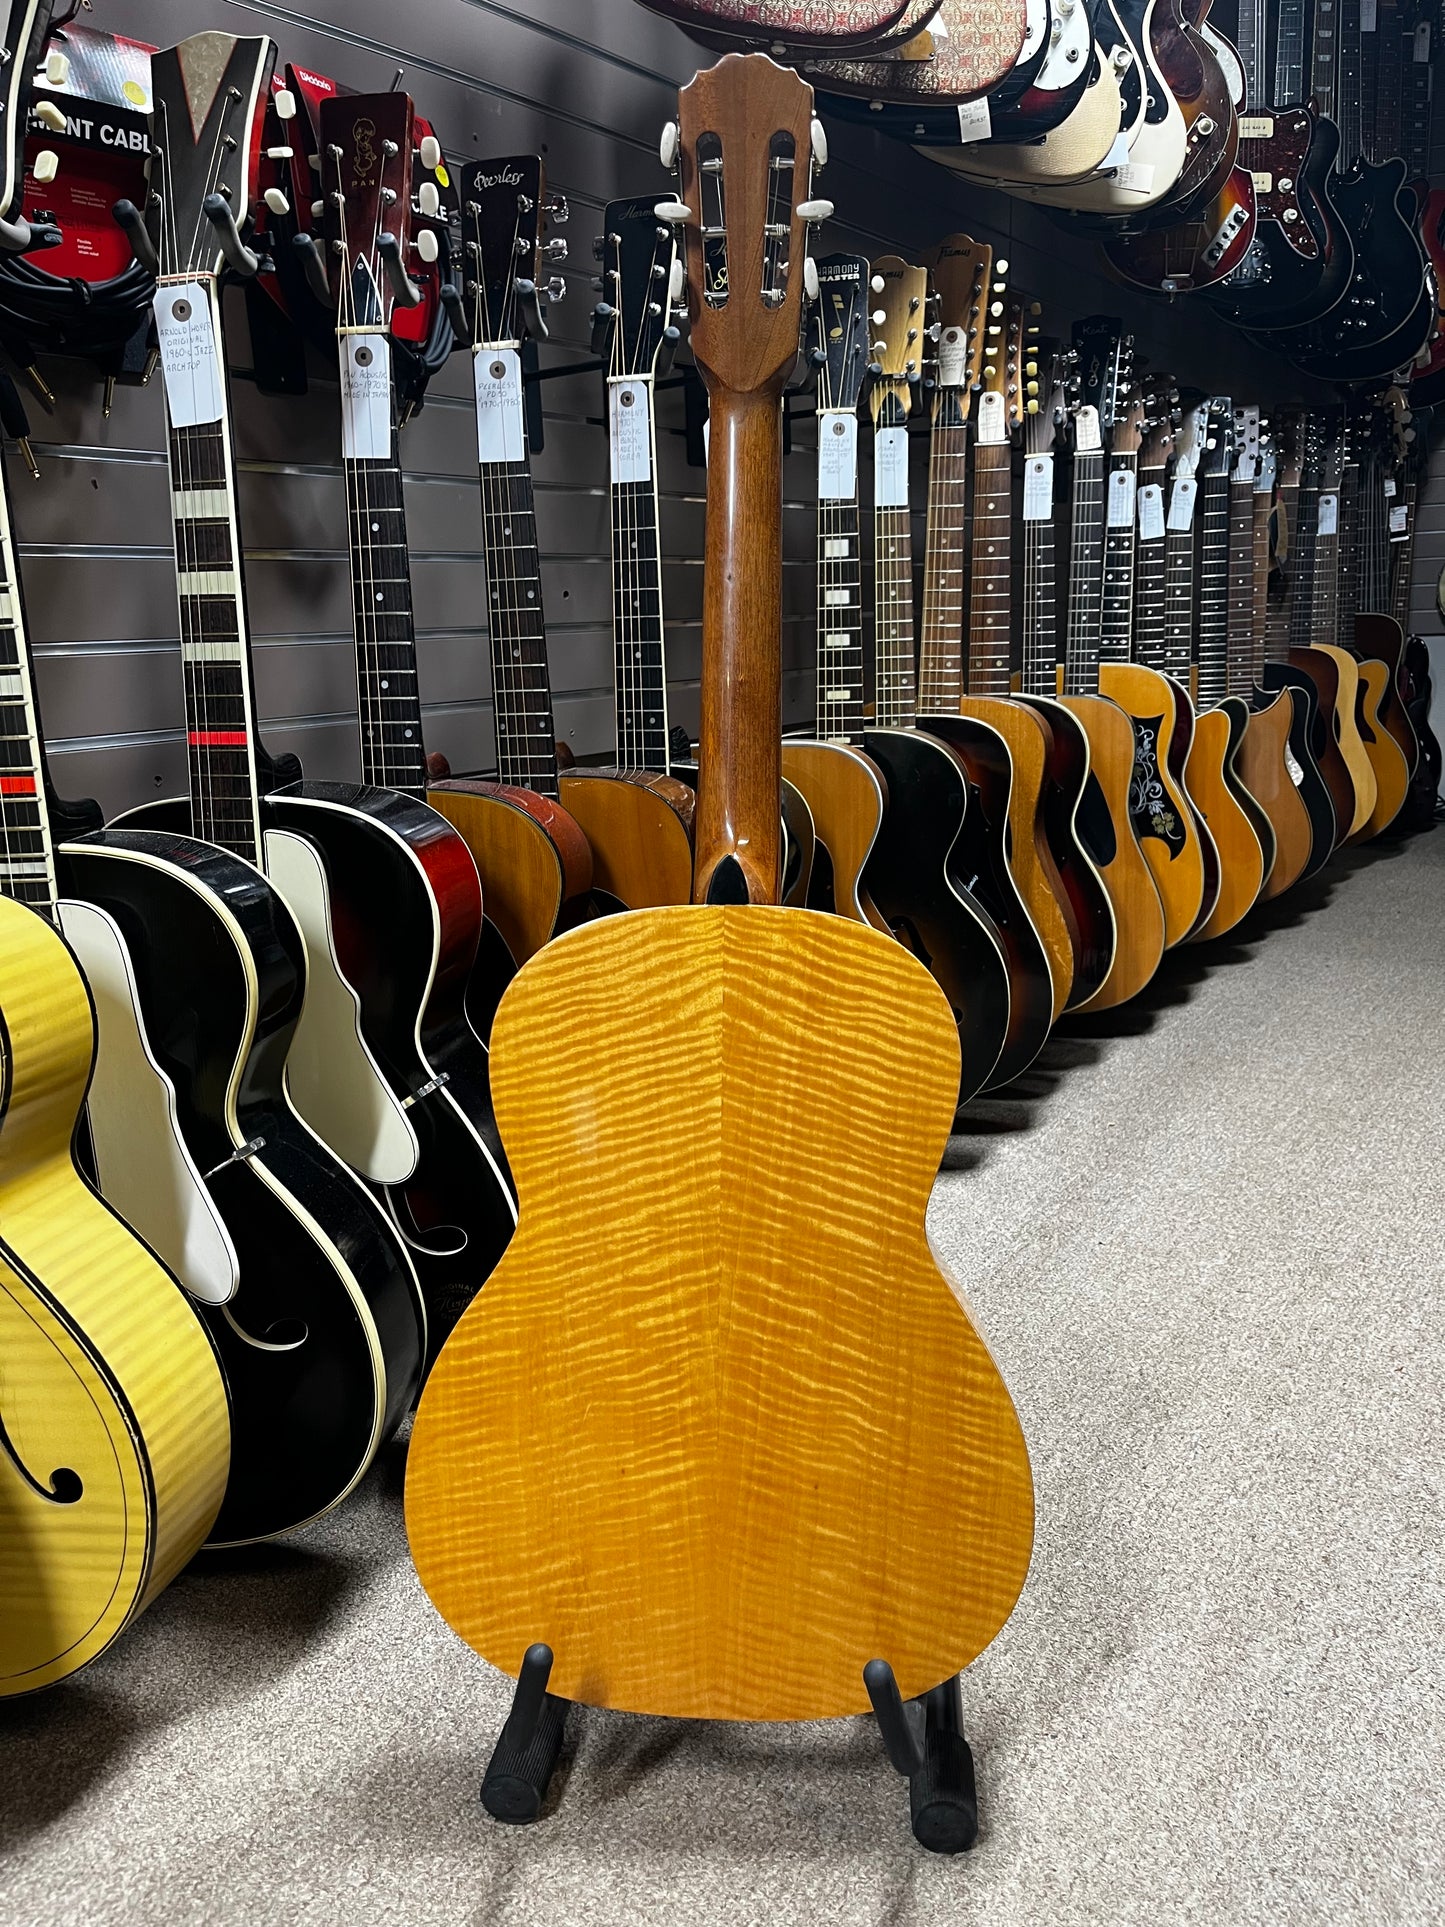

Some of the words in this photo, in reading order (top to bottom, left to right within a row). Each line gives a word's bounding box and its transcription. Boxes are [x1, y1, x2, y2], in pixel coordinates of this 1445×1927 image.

[100, 124, 152, 154] CABL
[351, 179, 375, 187] PAN
[473, 164, 525, 192] Peerless
